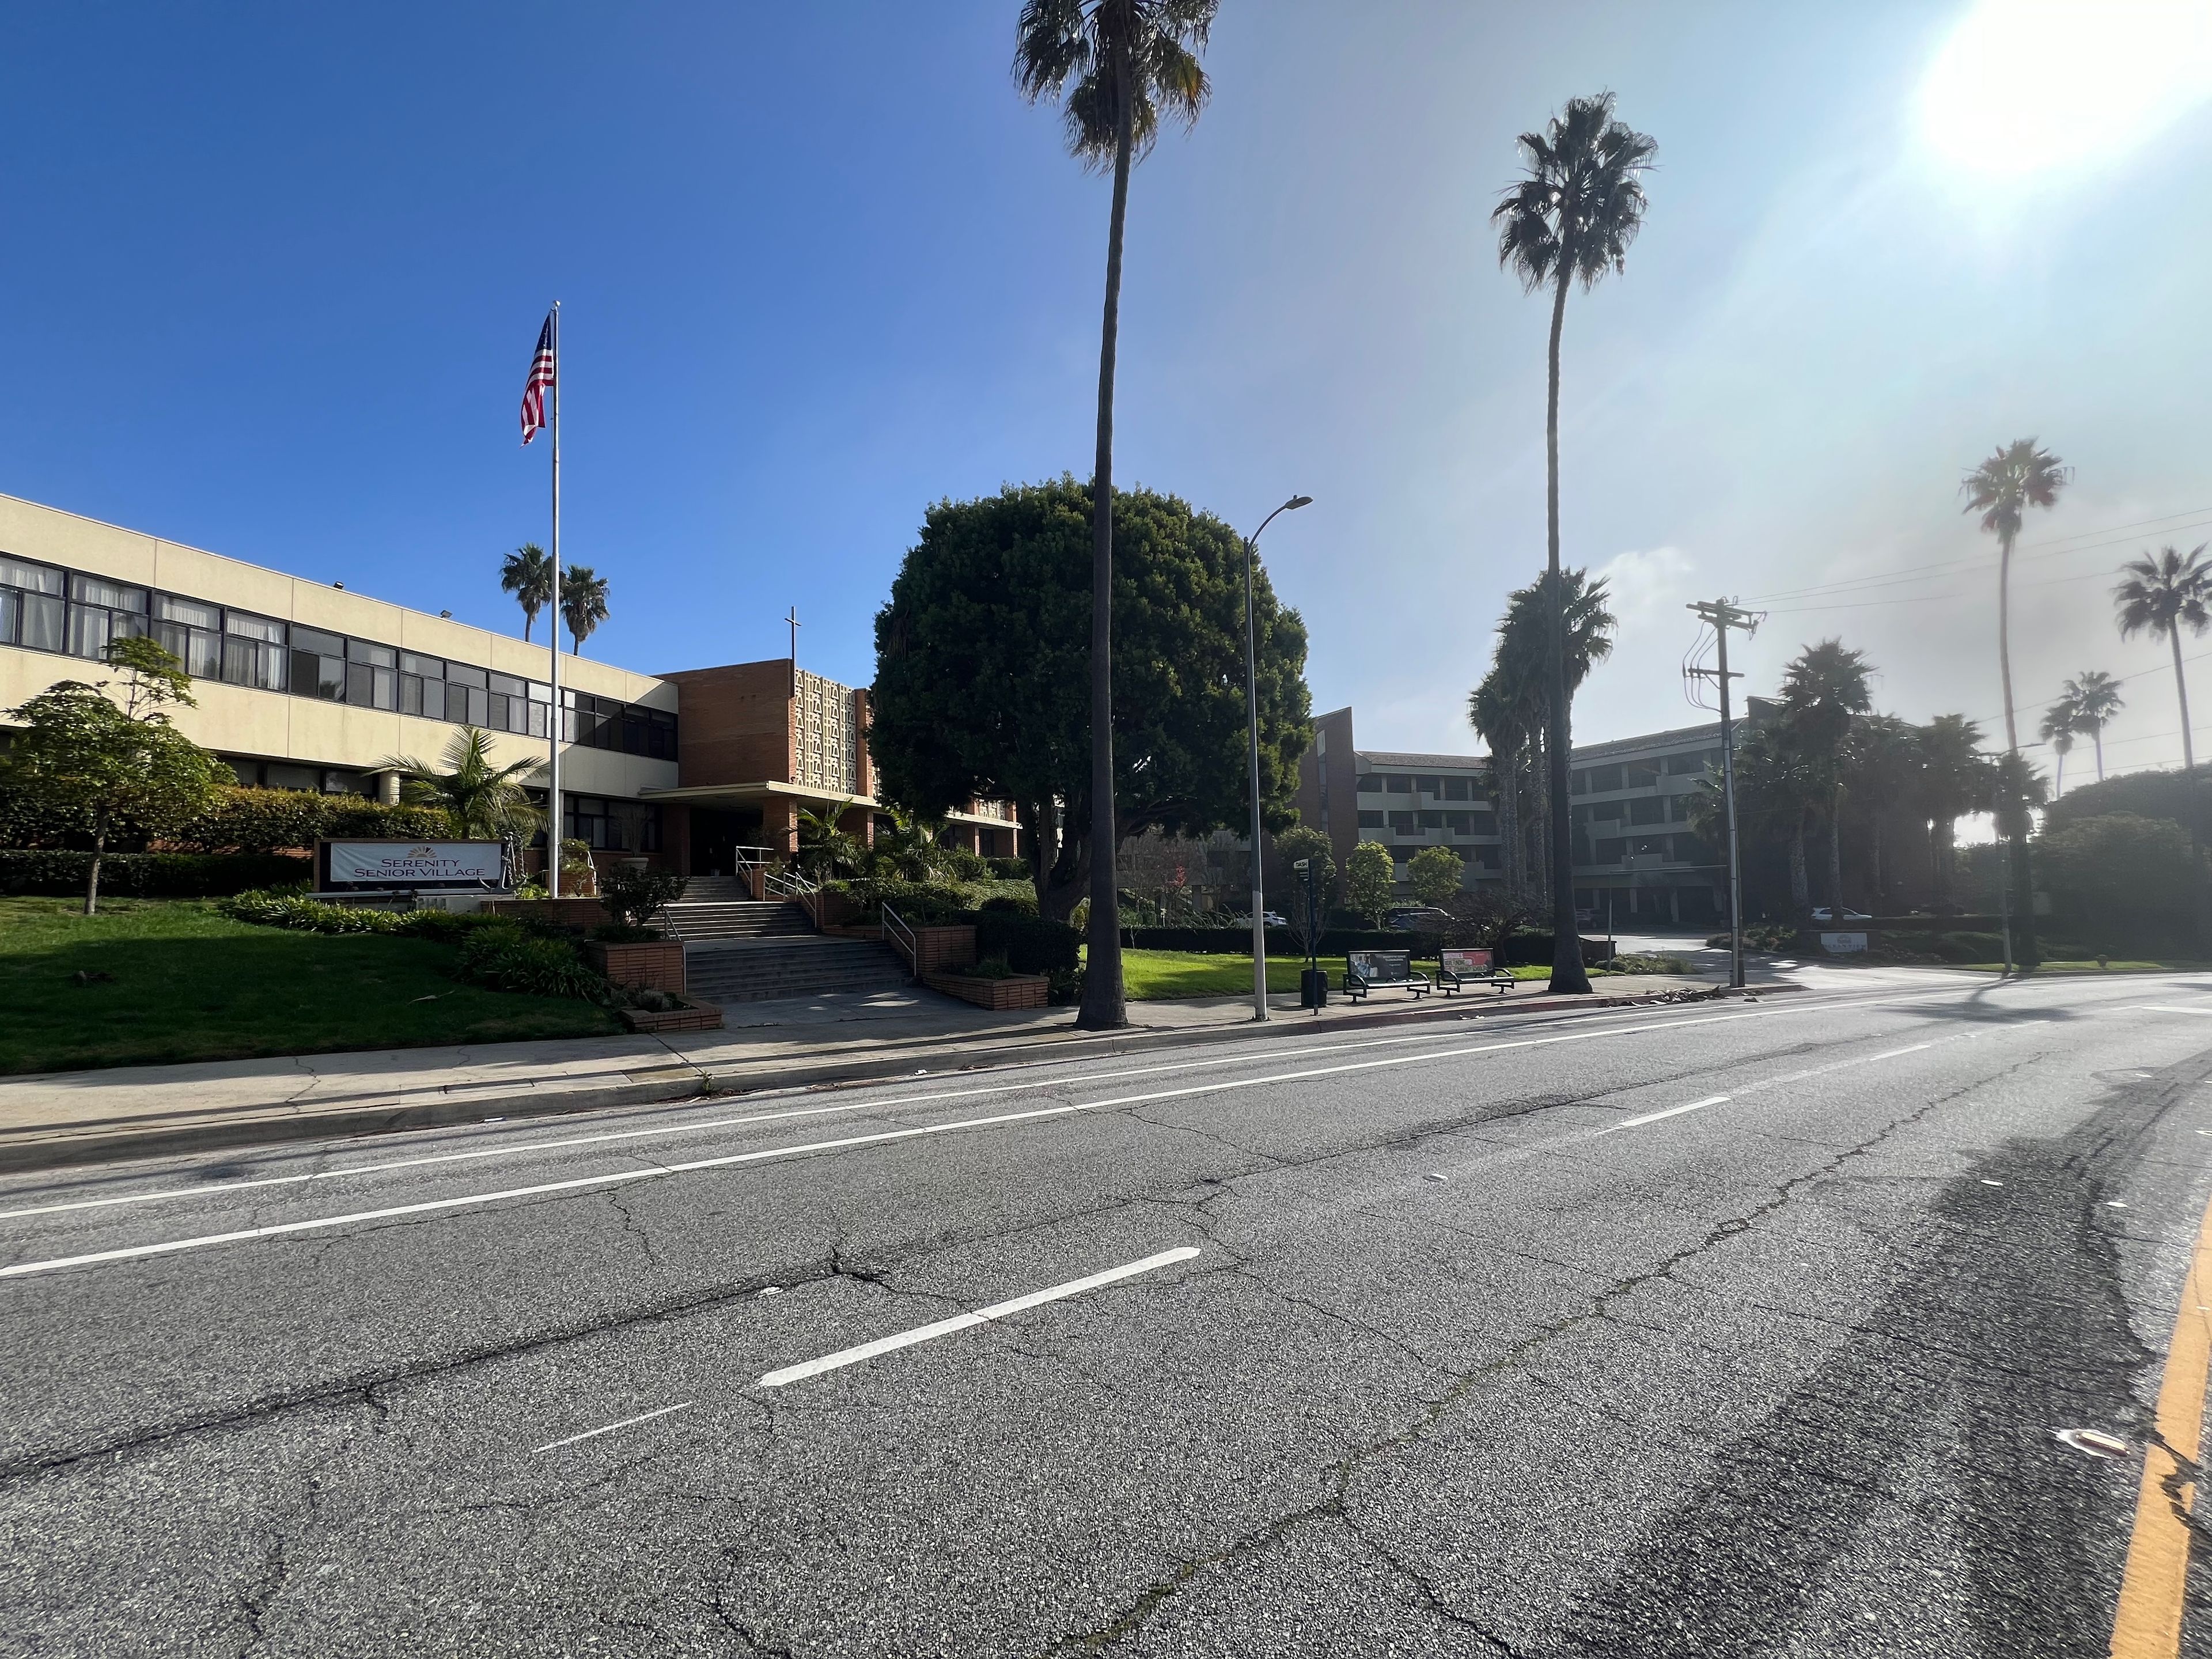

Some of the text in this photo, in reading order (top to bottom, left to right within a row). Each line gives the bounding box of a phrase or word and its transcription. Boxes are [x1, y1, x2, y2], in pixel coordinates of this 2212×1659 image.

[381, 859, 460, 868] SERENITY
[354, 869, 486, 877] SENIOR VILLAGE
